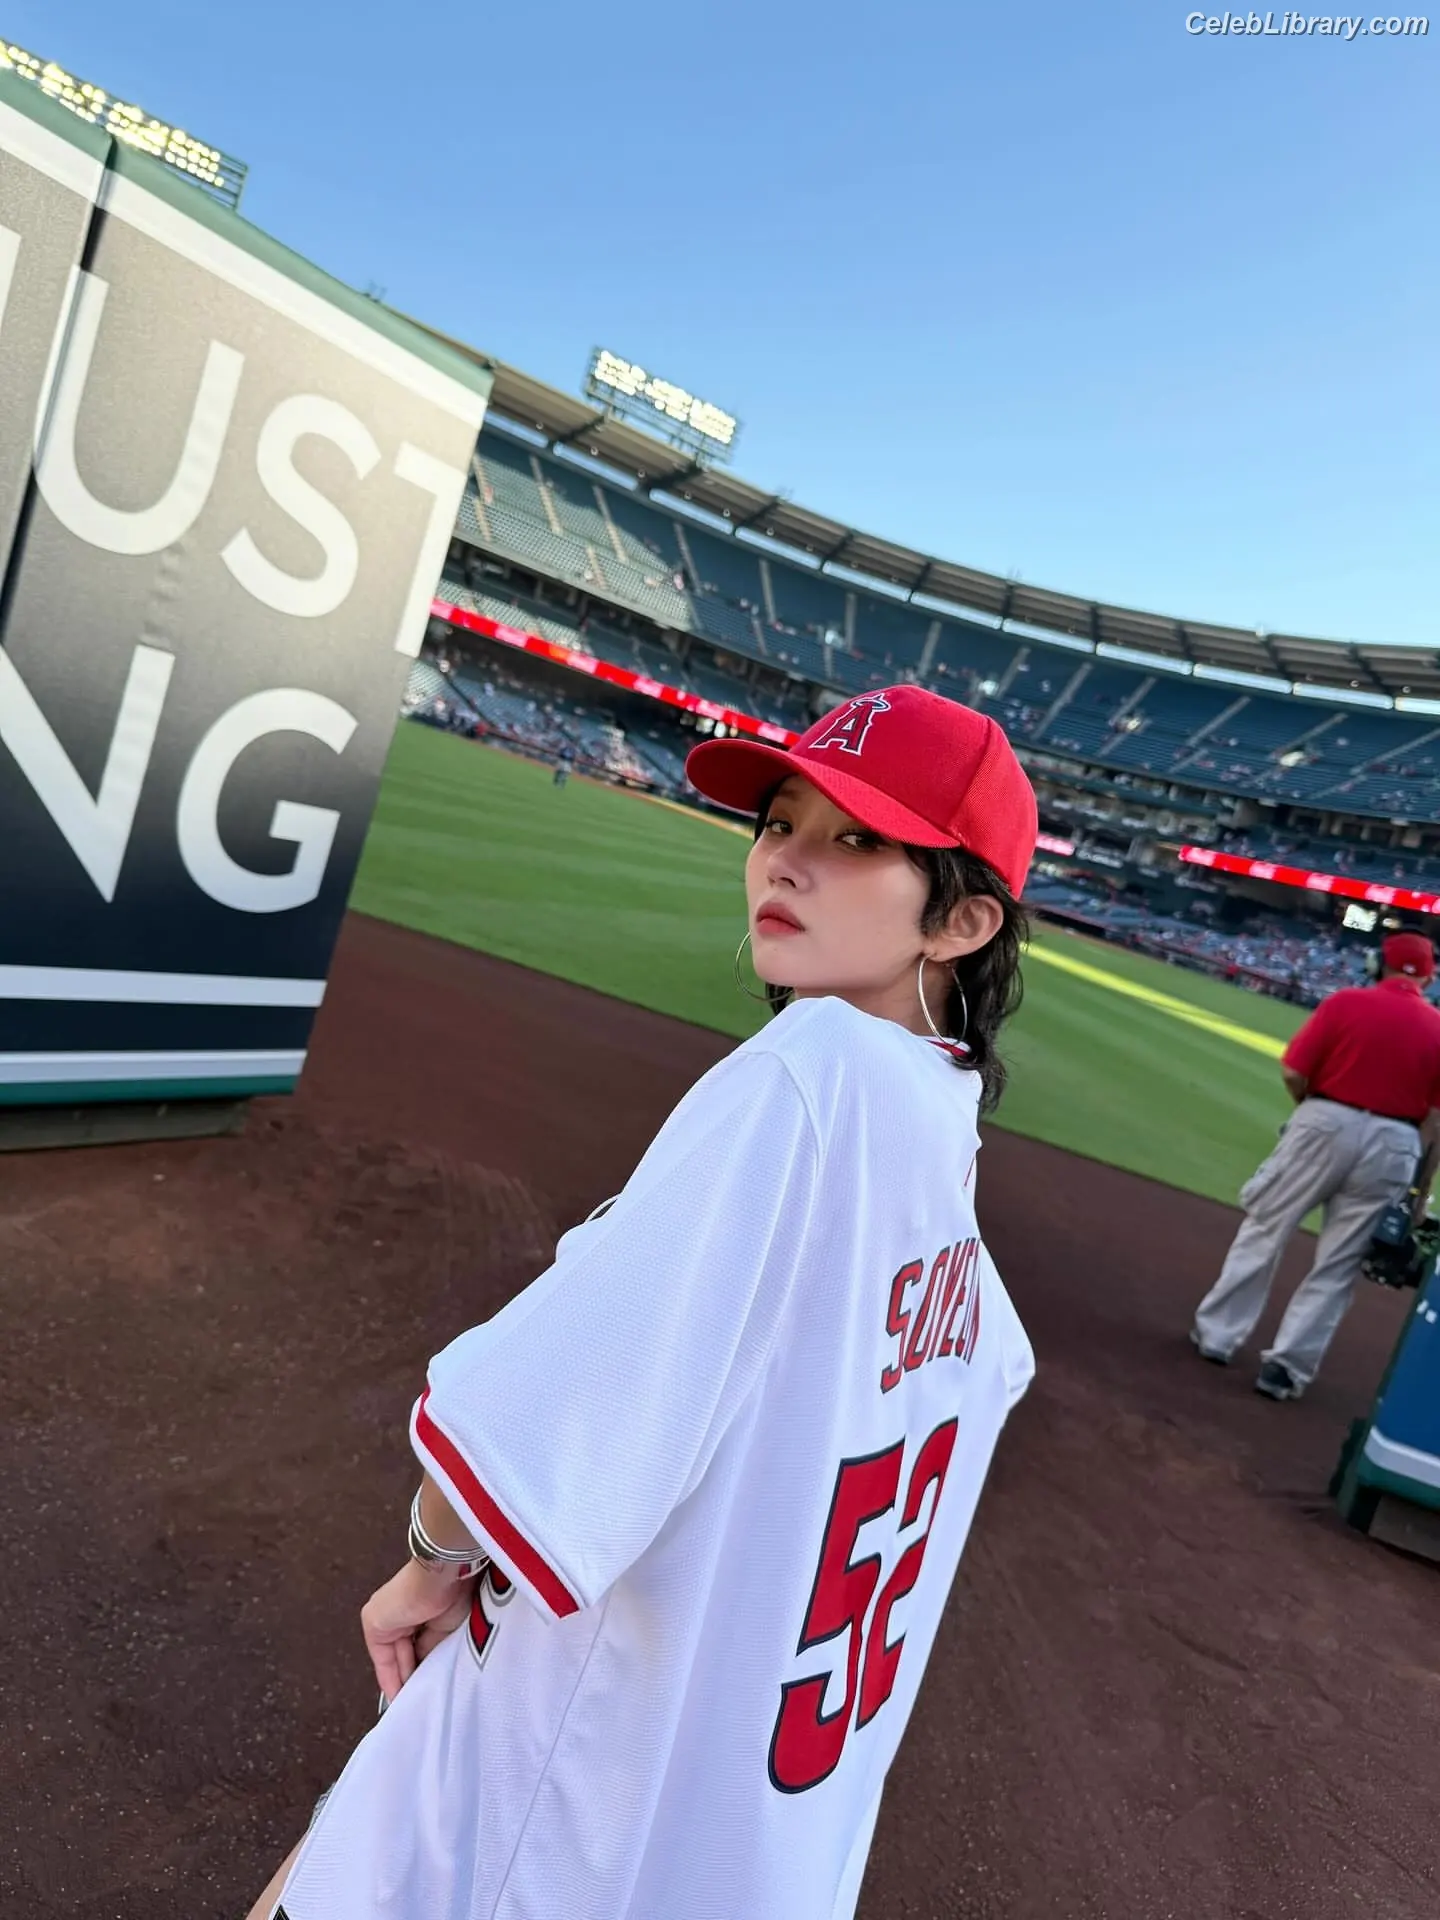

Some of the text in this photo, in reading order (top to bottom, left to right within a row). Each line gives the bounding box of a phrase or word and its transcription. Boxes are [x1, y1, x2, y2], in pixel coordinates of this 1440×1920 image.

[0, 223, 466, 657] UST
[808, 692, 892, 756] A
[767, 1415, 958, 1795] 52
